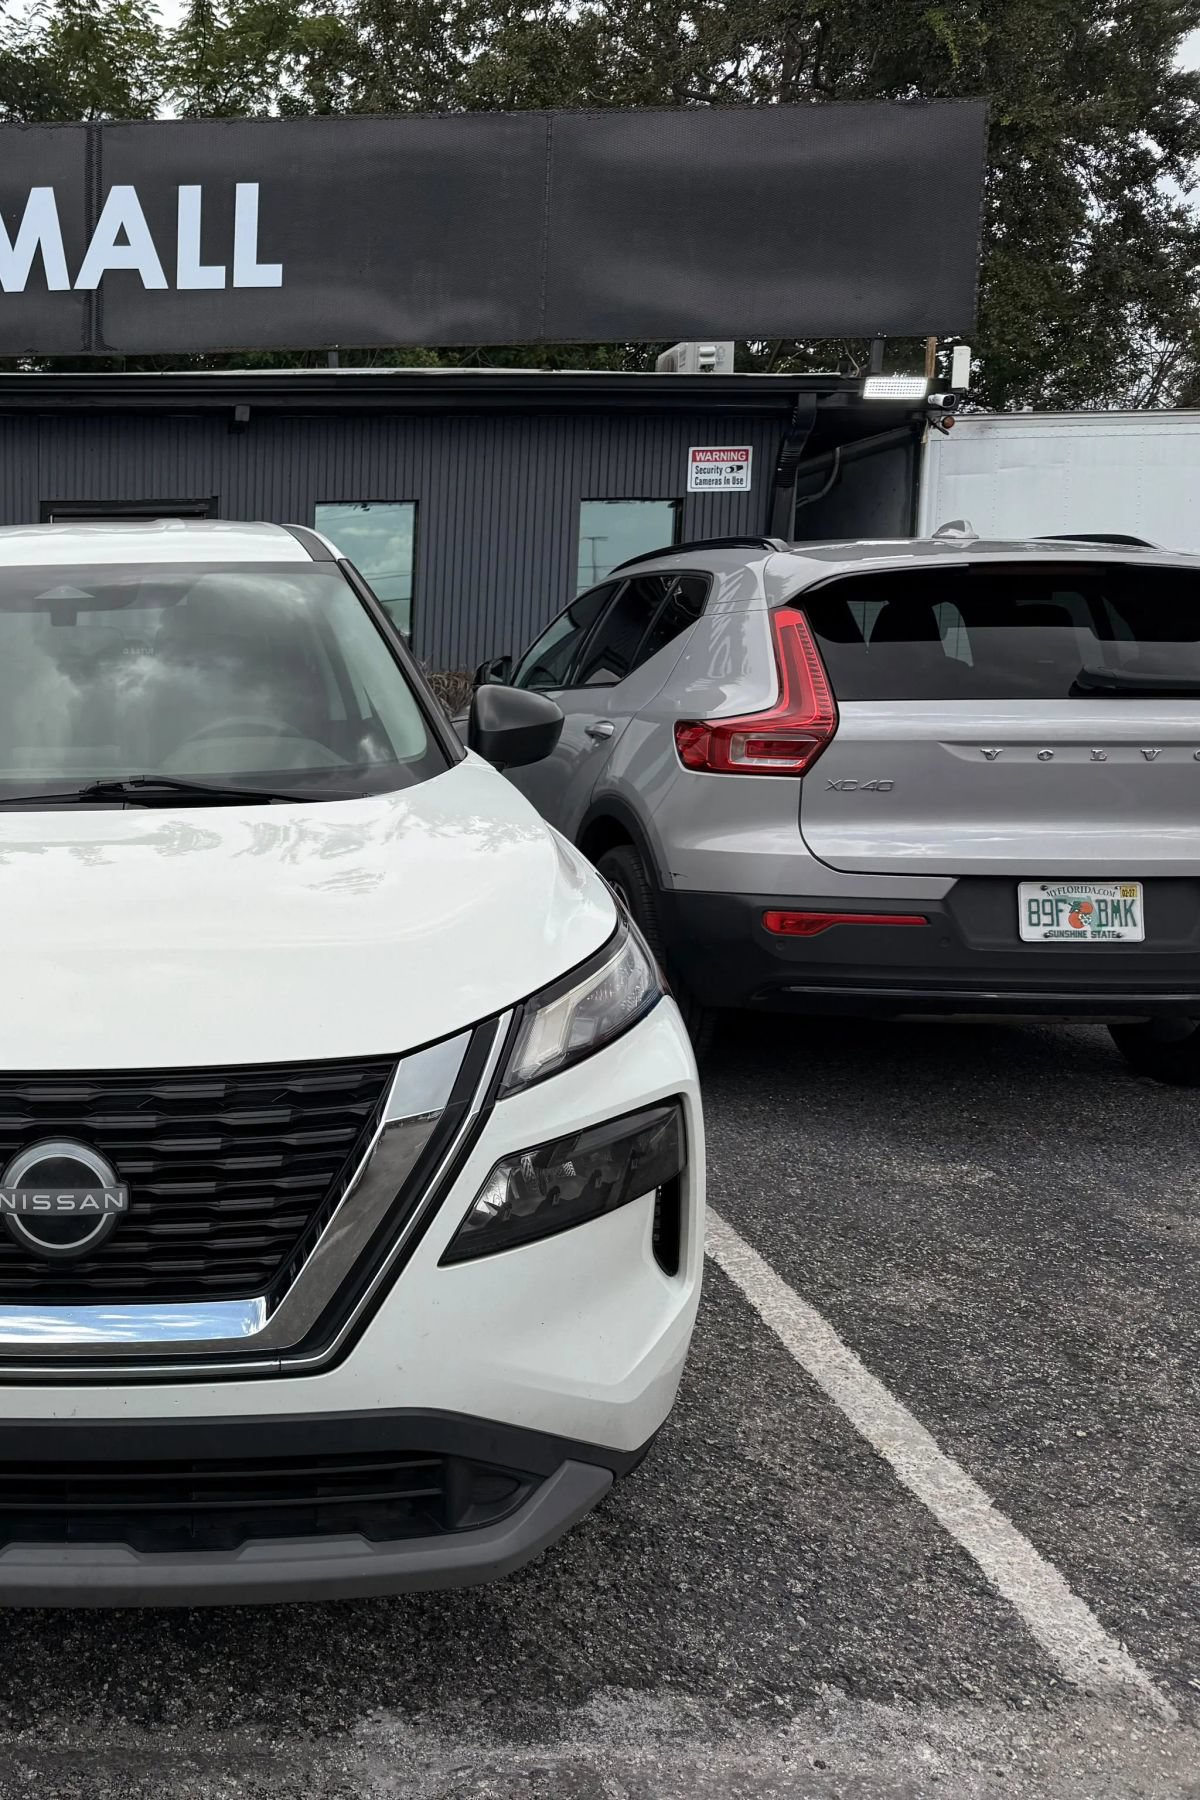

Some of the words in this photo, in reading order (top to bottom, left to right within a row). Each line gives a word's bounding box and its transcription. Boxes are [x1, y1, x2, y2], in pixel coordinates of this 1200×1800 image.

[695, 451, 746, 461] WARNING
[695, 465, 723, 476] Security
[695, 476, 722, 486] Cameras
[724, 476, 730, 485] In
[732, 476, 744, 485] Use
[1046, 886, 1116, 897] MYFLORIDA.COM
[1027, 898, 1068, 927] 89F
[1095, 898, 1138, 927] BMK
[1047, 930, 1088, 938] SUNSHINE
[1090, 930, 1117, 938] STATE
